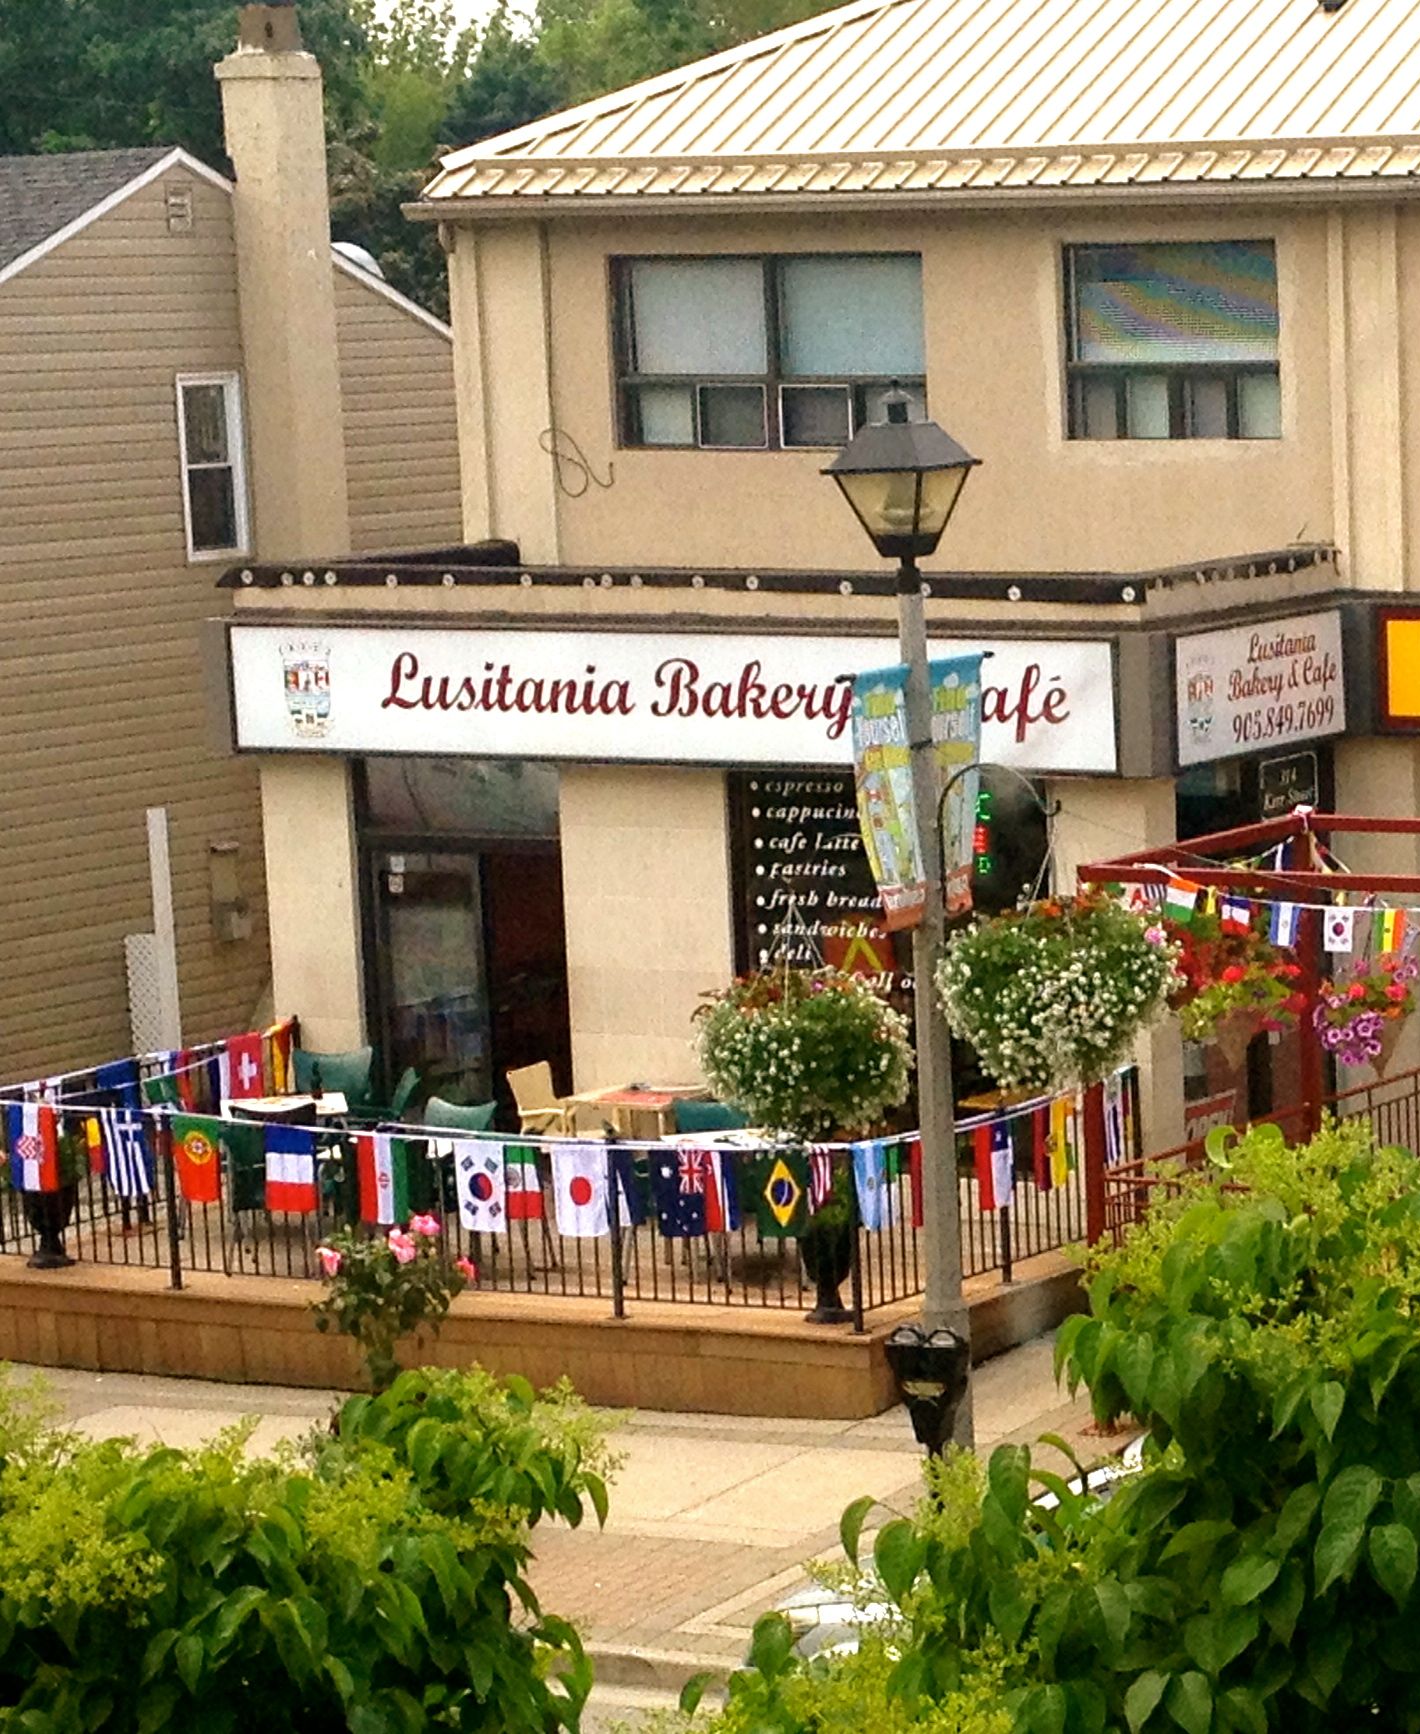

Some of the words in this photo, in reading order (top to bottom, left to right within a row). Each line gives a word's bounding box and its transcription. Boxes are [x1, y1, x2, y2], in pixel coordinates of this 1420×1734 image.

[1247, 633, 1317, 664] Lusitania
[1228, 666, 1284, 702] Bakery
[1287, 659, 1299, 689] &
[381, 652, 636, 716] Lusitania
[650, 657, 852, 740] Bakery
[979, 661, 1071, 743] afé
[1232, 695, 1335, 743] 905.849.7699
[765, 781, 844, 797] espresso
[769, 859, 847, 880] pastries
[764, 888, 819, 910] fresh
